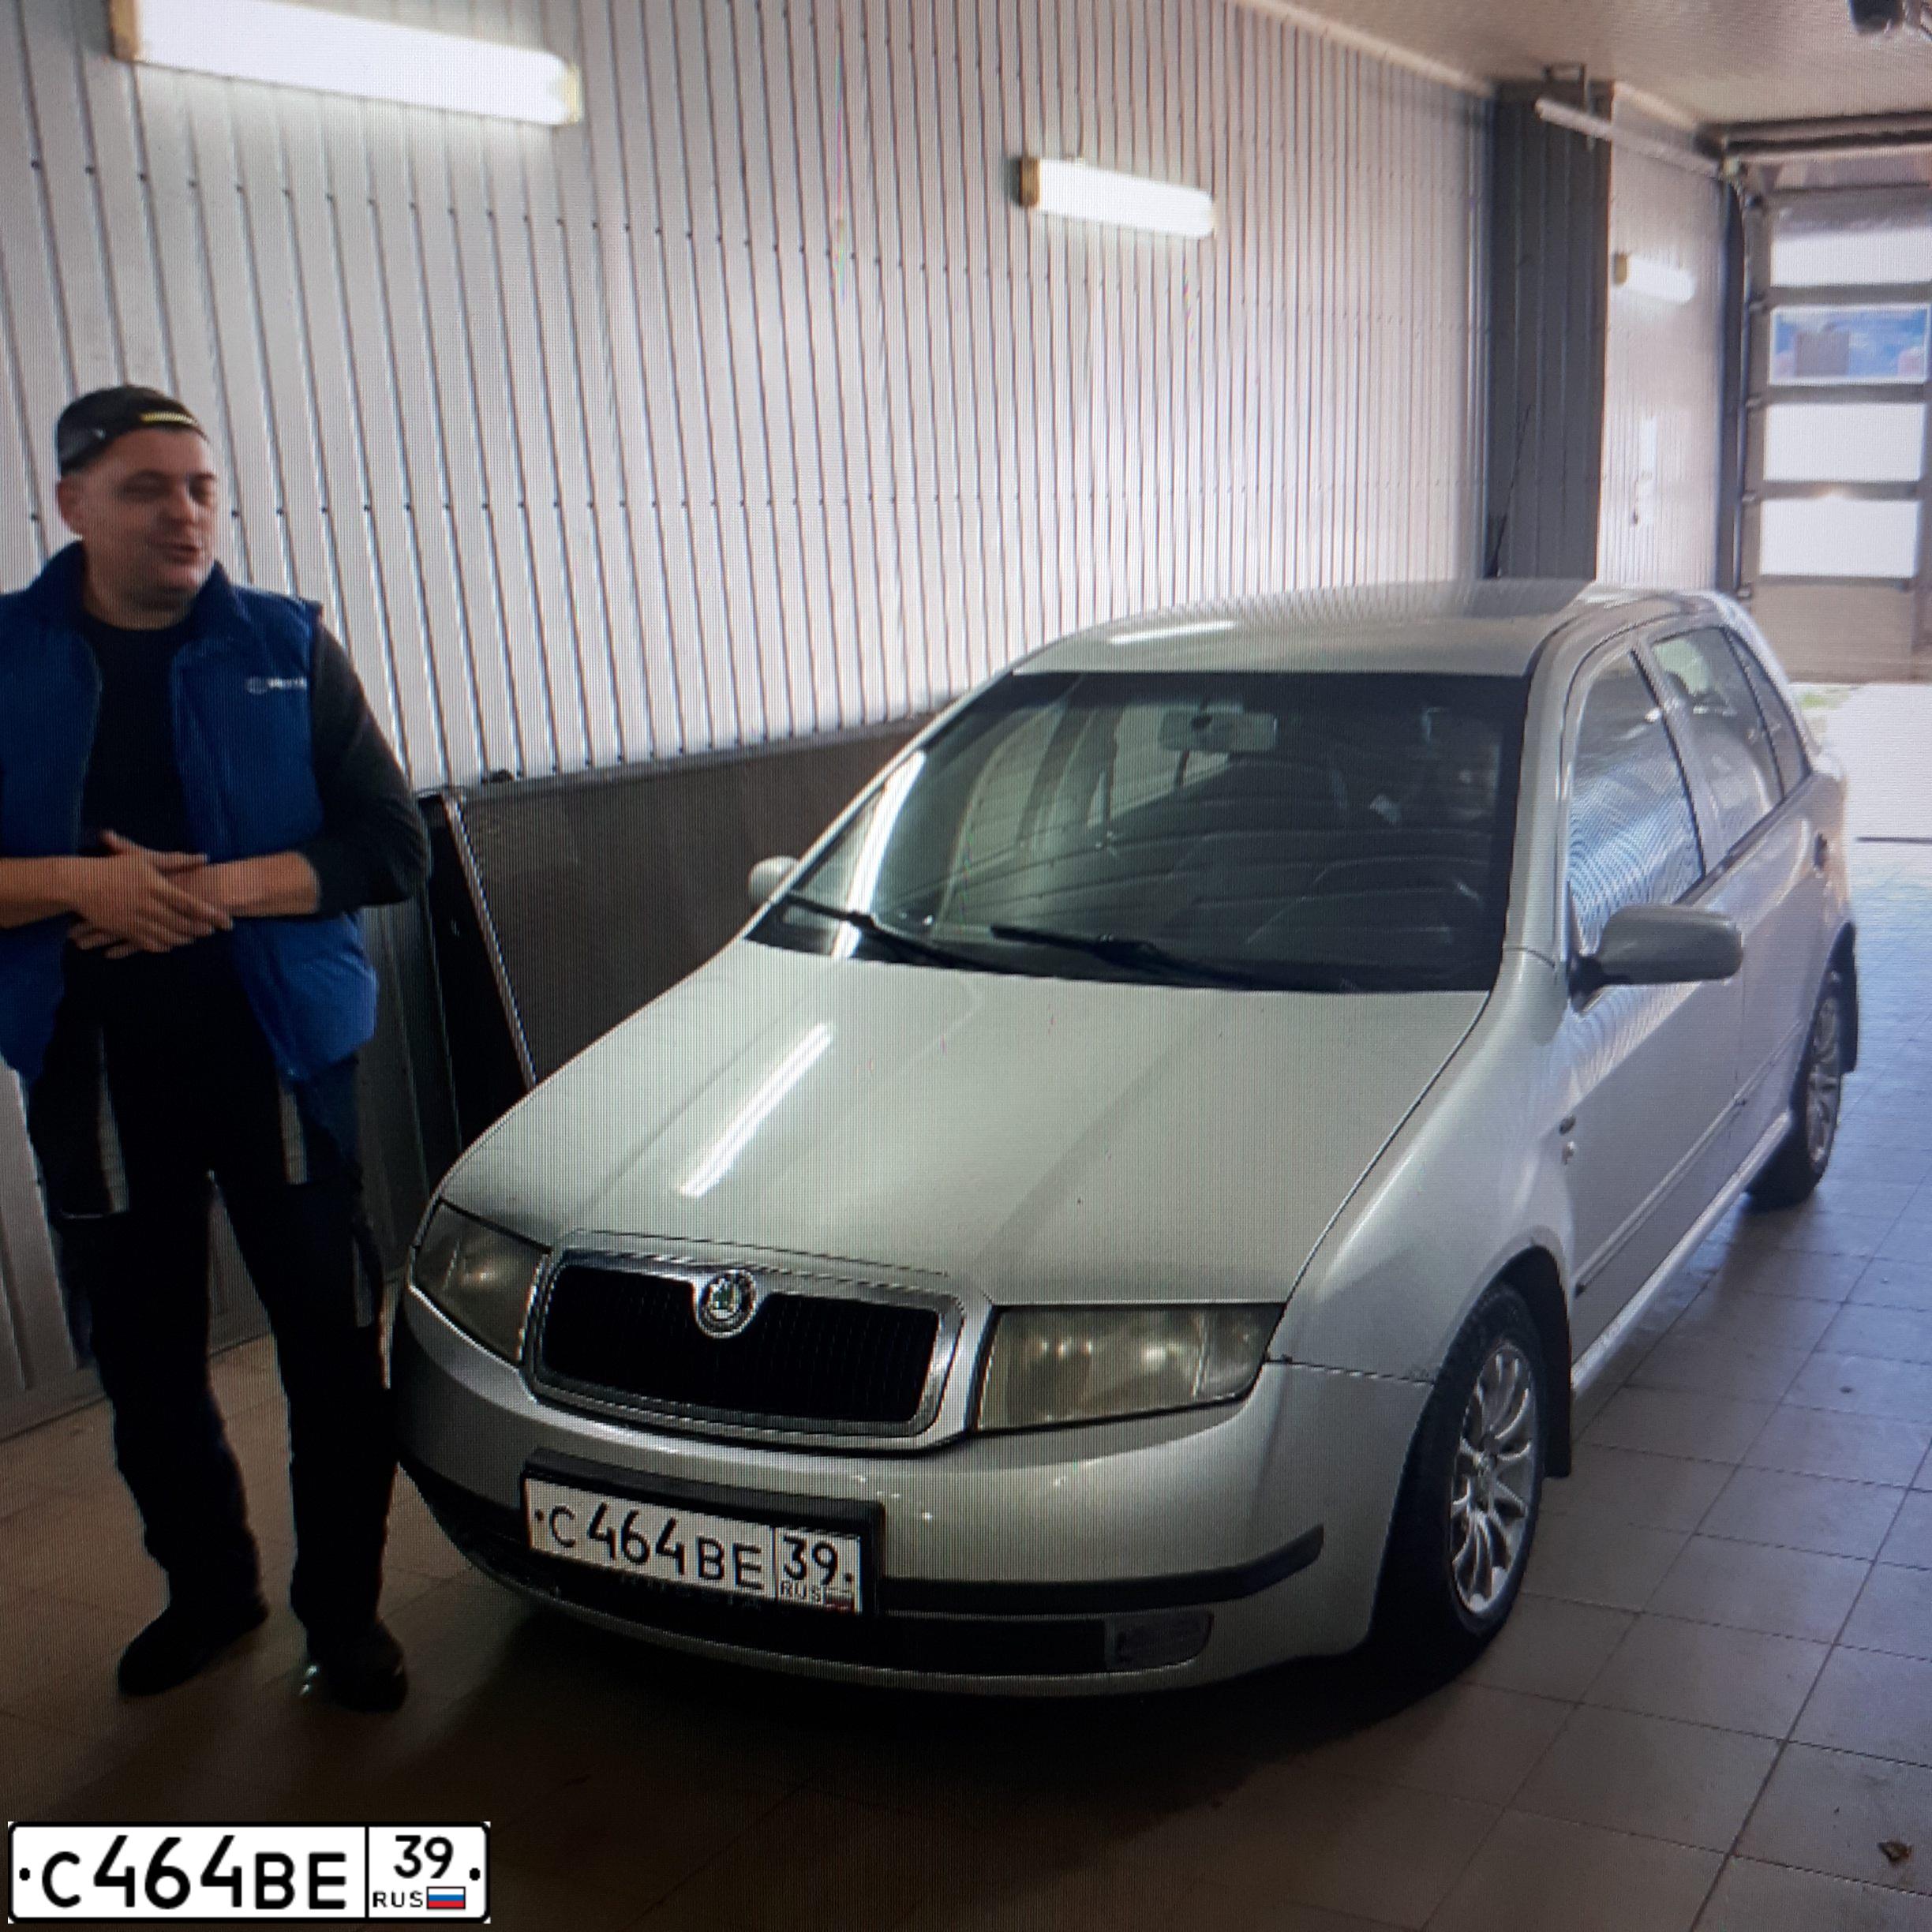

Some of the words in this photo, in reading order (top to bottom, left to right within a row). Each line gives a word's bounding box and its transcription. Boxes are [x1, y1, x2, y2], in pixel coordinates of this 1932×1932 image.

[549, 1502, 764, 1589] С464ВЕ
[783, 1536, 838, 1586] 39
[780, 1580, 822, 1602] RUS
